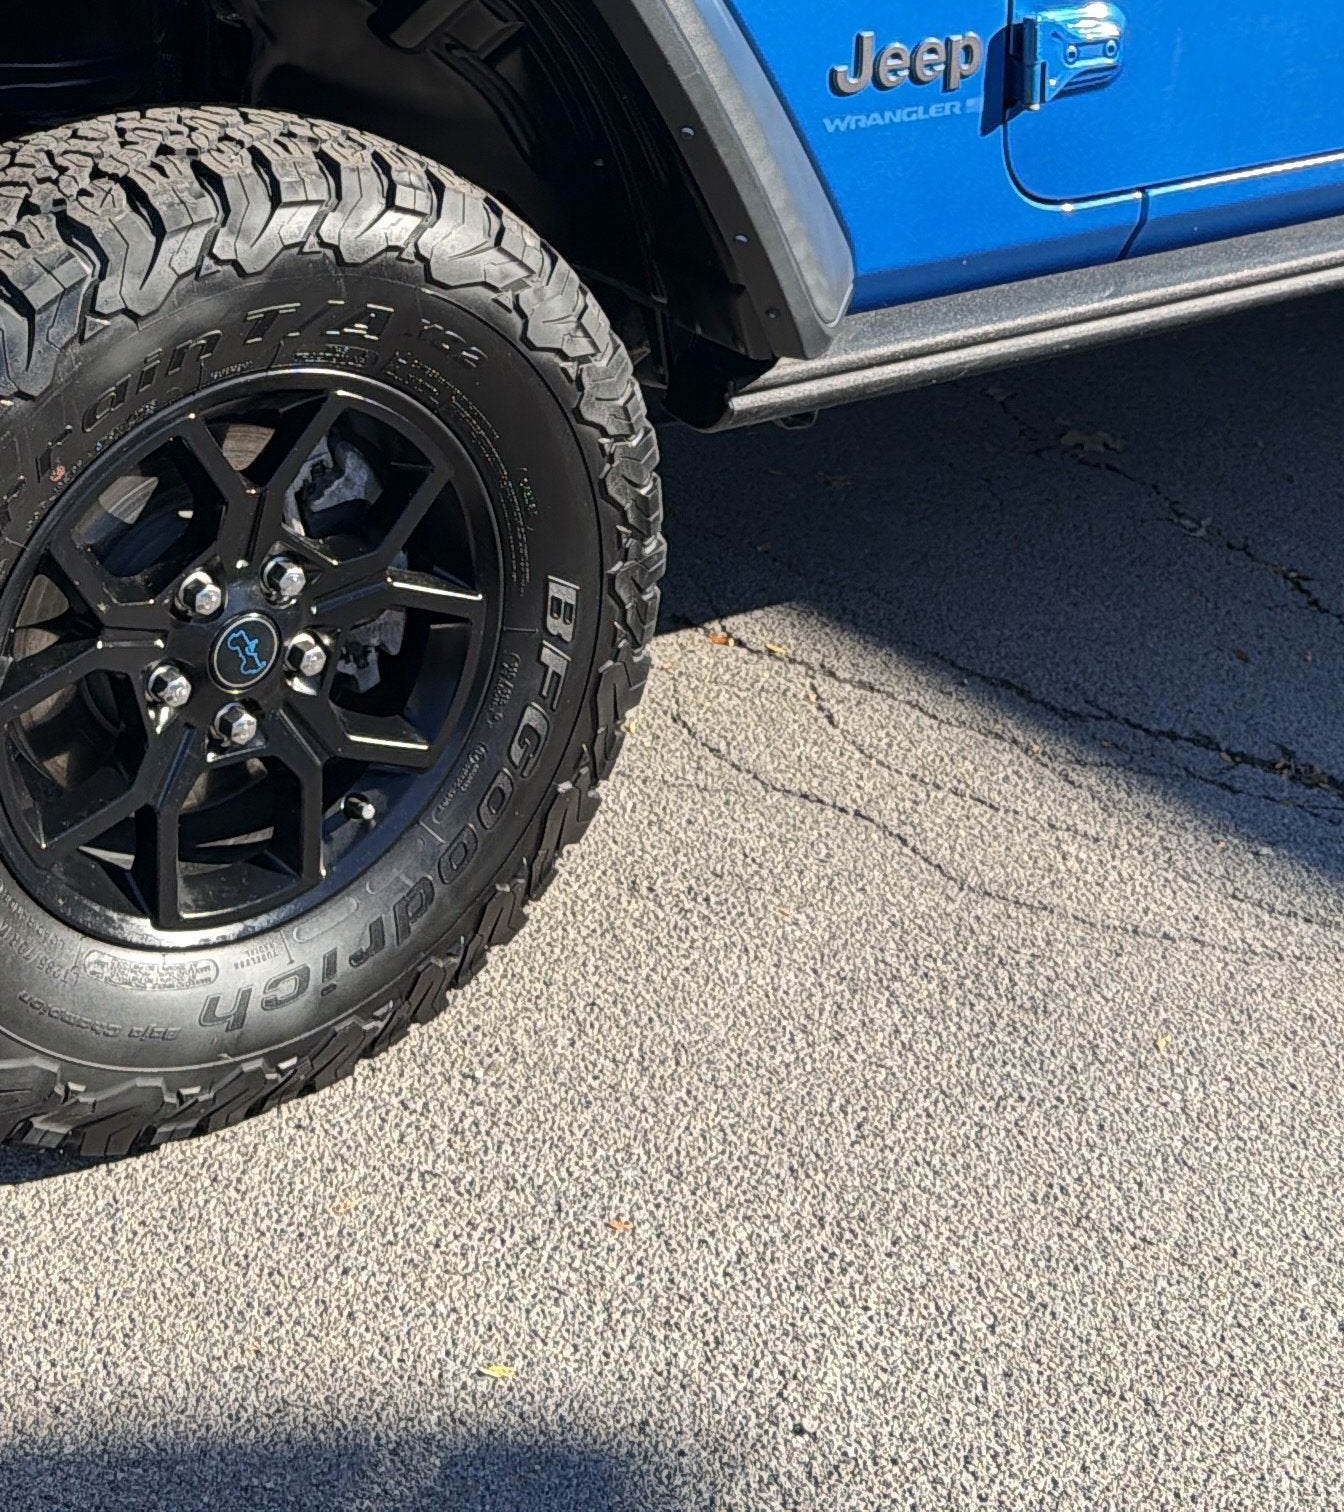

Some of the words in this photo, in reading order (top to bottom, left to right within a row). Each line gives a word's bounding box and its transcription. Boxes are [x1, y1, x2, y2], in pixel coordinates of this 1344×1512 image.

[829, 31, 982, 97] Jeep
[823, 99, 961, 133] WRANGLER
[199, 575, 580, 1032] BFGoodrich
